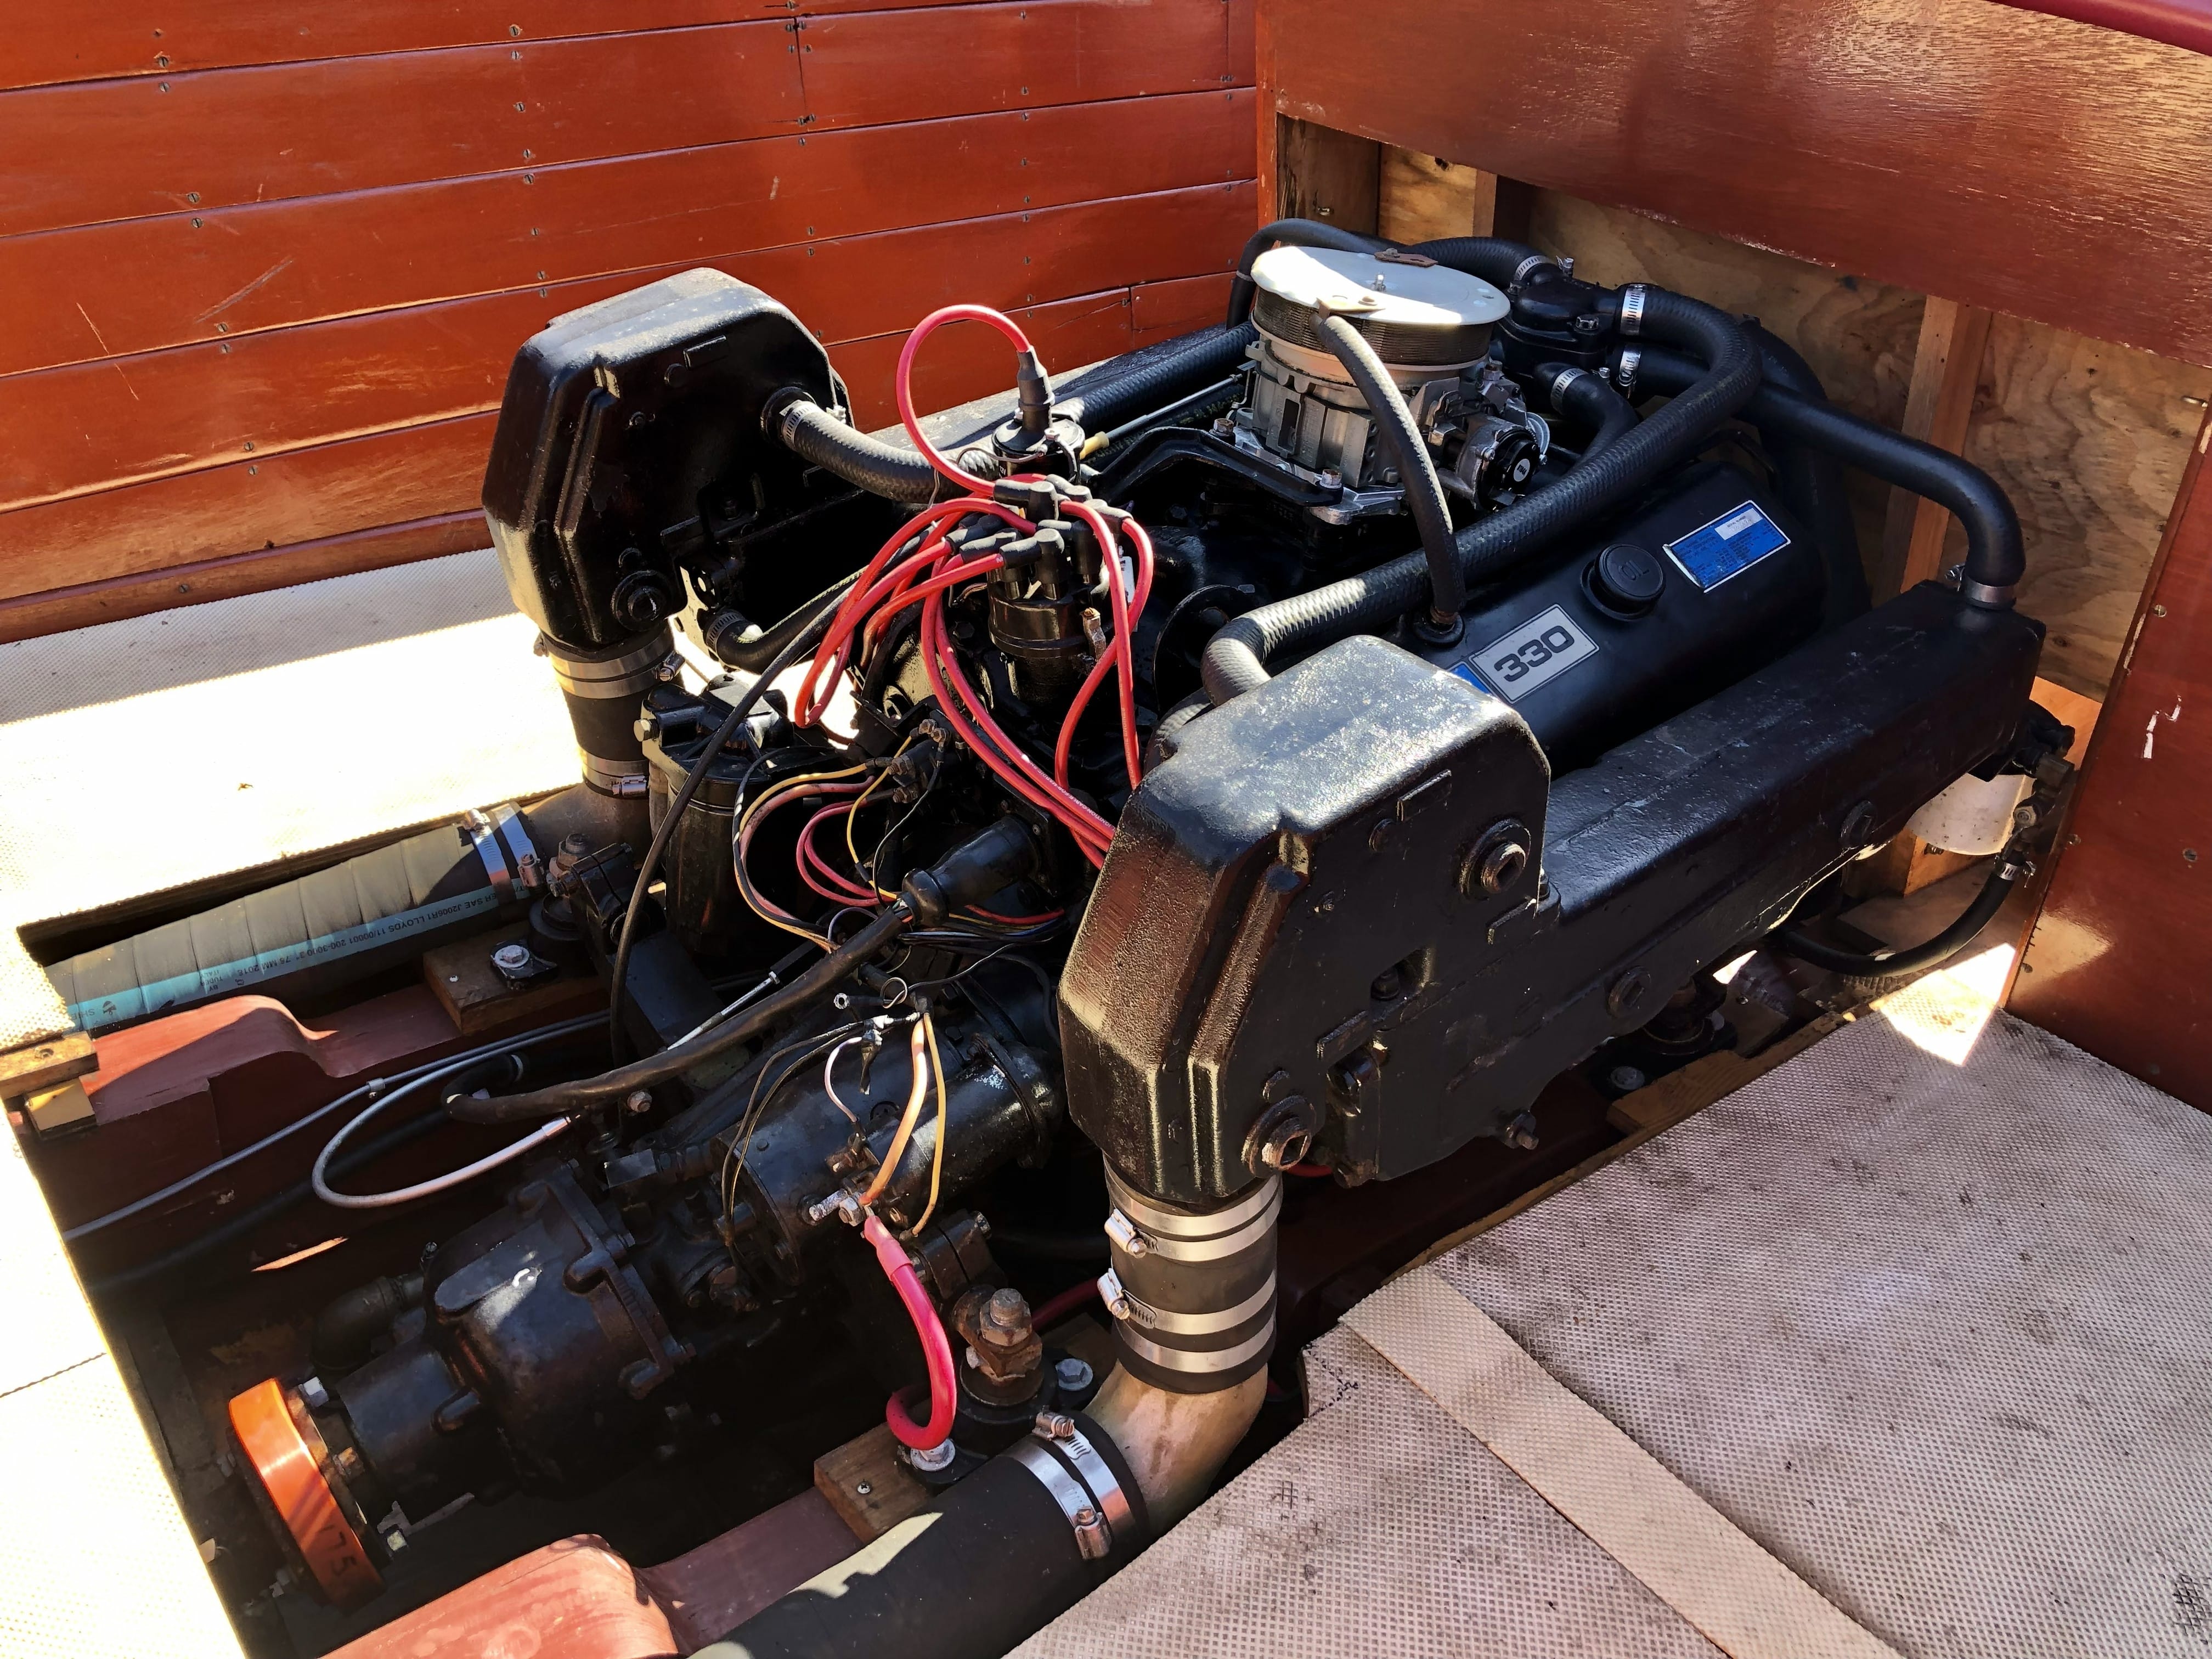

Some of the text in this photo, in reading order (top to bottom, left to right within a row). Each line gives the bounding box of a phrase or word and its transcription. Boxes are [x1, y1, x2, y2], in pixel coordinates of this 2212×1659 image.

[1619, 560, 1650, 580] OIL
[1494, 625, 1575, 682] 330
[1087, 809, 1111, 828] IGNITION
[427, 904, 462, 921] J2006R1
[464, 898, 483, 909] SAE
[388, 915, 425, 933] LLOYDS
[349, 927, 386, 945] 11/00001
[263, 961, 278, 971] MM
